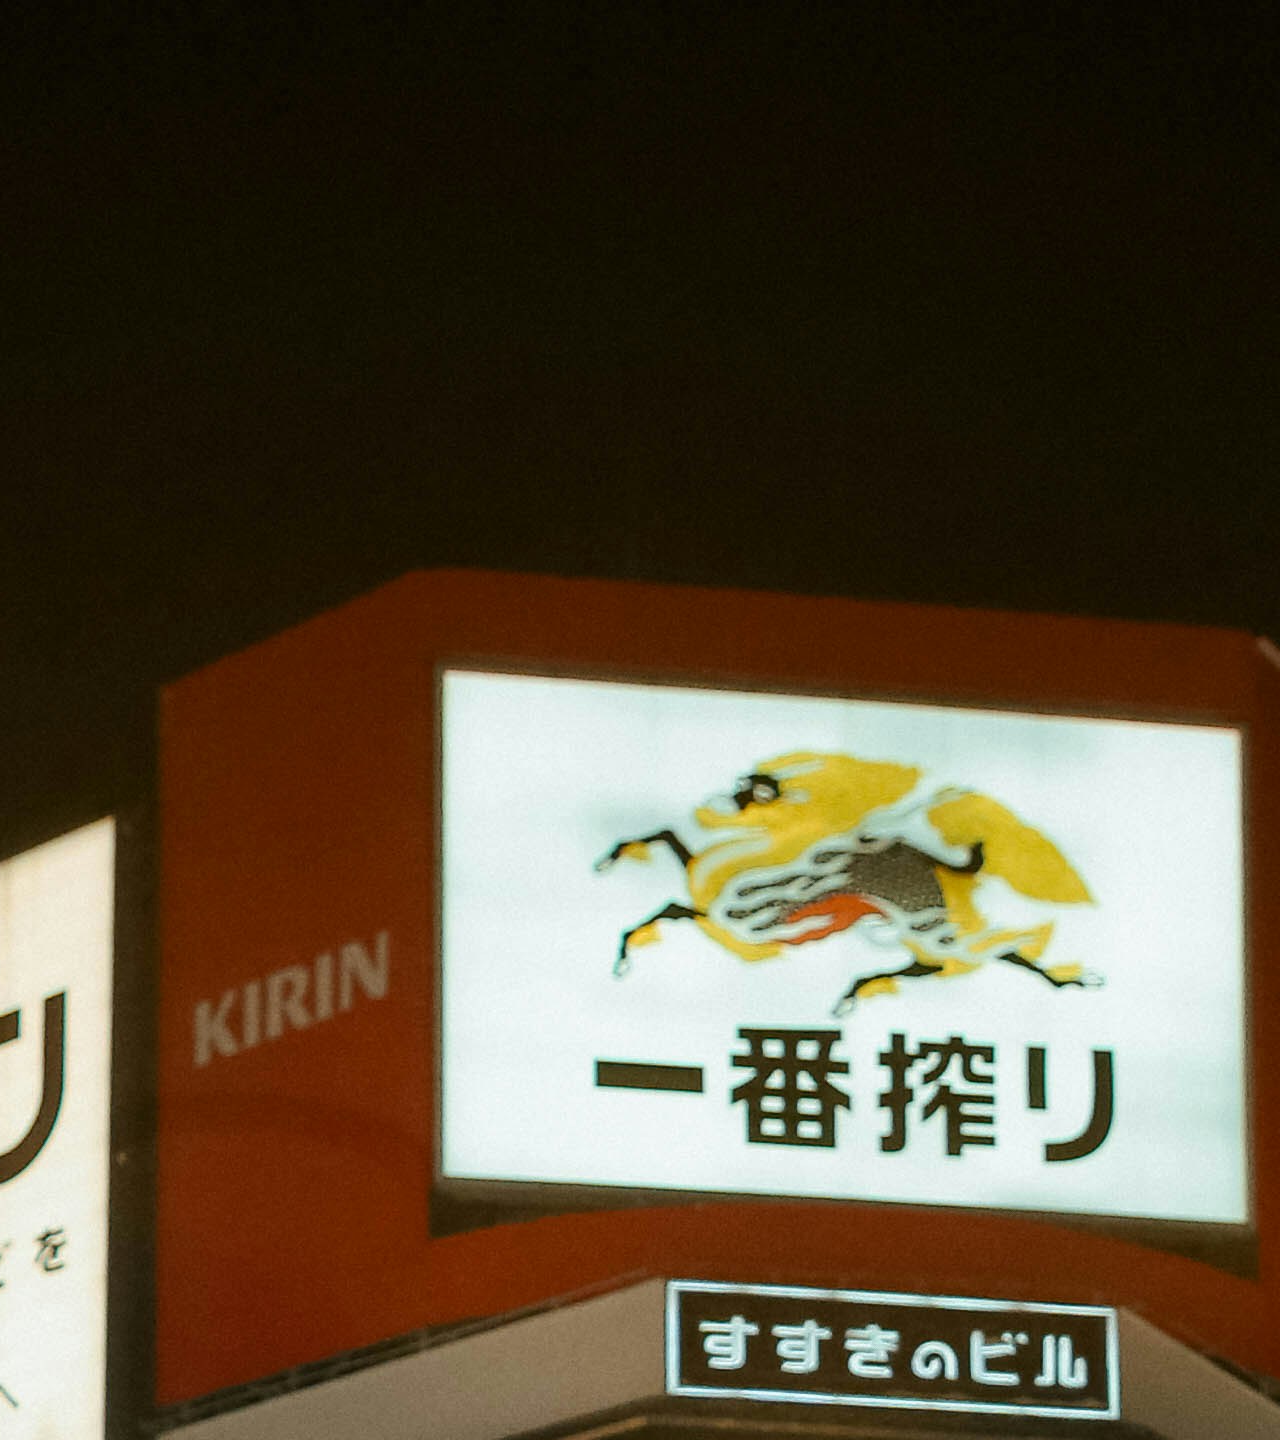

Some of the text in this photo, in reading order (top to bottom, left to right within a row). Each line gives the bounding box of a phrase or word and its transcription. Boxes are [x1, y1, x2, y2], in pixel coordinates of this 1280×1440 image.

[190, 932, 391, 1069] KIRIN
[593, 1025, 1116, 1164] 一番搾り
[700, 1314, 1088, 1392] すすきのビル
